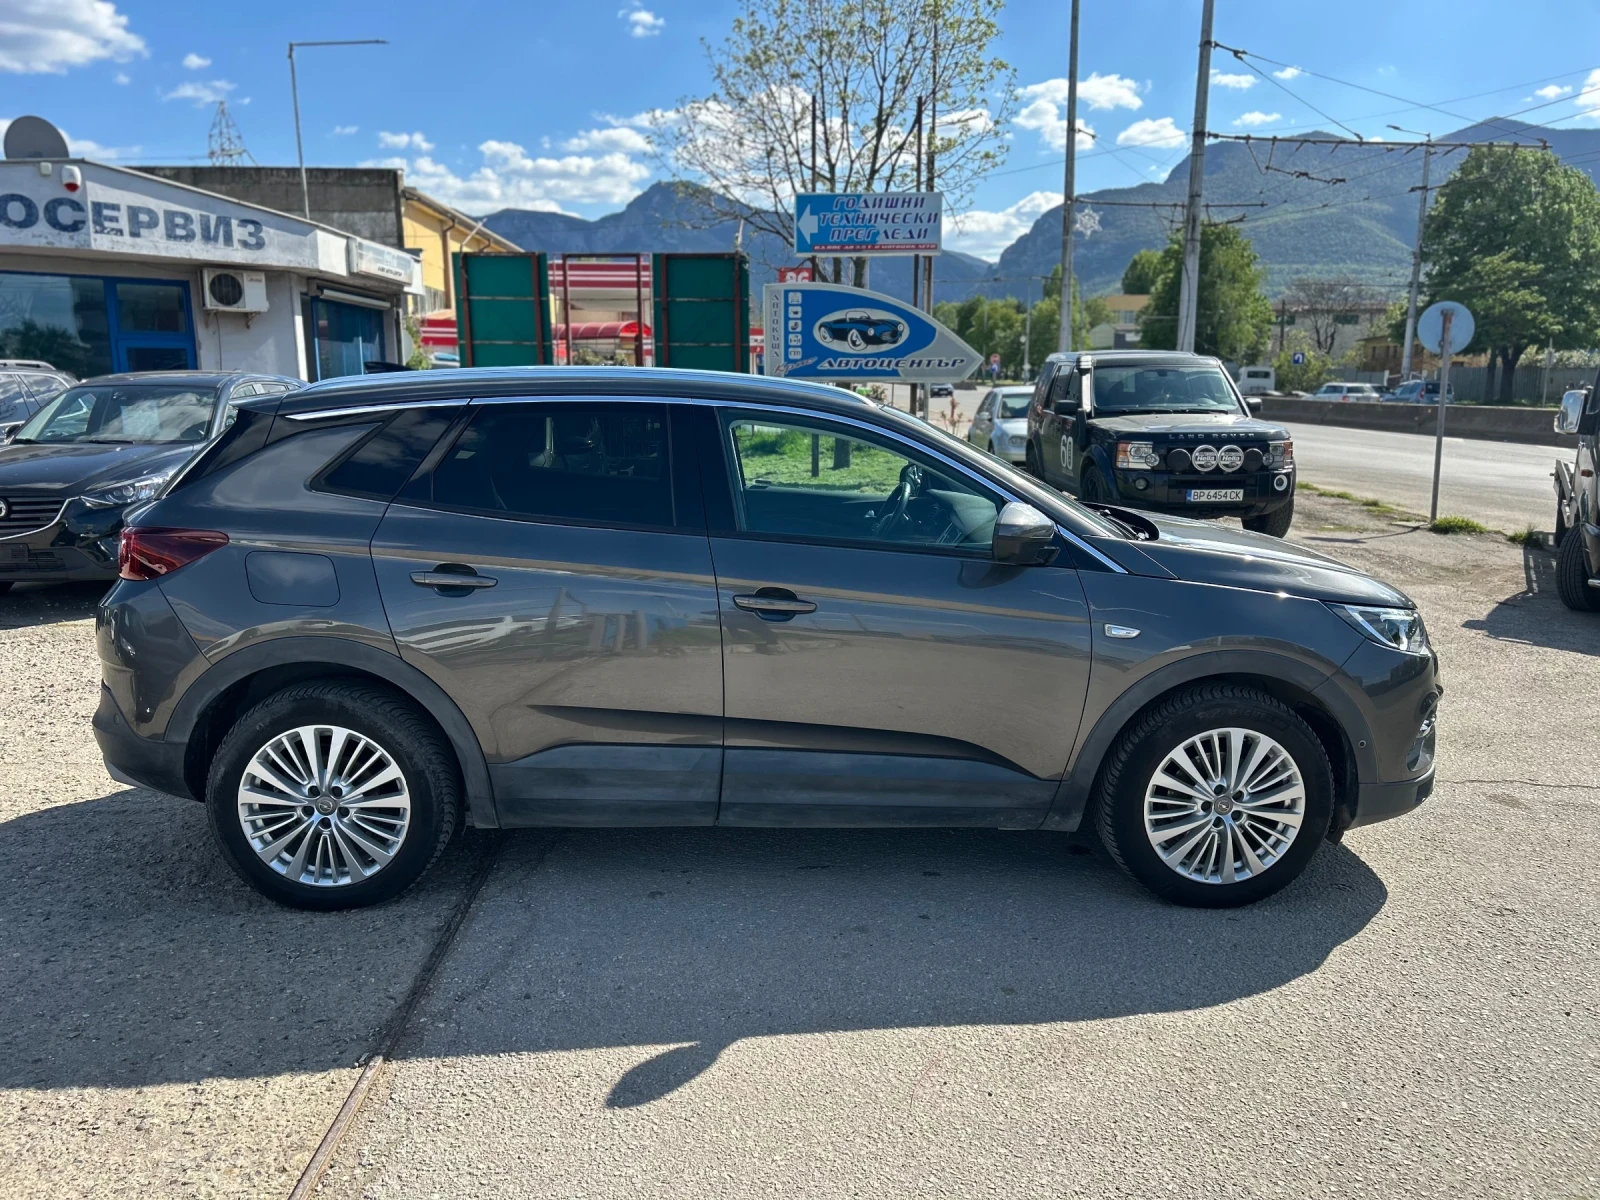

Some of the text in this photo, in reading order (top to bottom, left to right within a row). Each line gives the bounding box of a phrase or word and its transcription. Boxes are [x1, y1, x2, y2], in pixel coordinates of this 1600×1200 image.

[834, 196, 925, 209] ГОДИШНИ
[0, 193, 266, 250] ОСЕРВИЗ
[820, 212, 938, 225] ТЕХНИЧЕСКИ
[830, 228, 929, 241] ПРЕГЛЕДИ
[817, 357, 966, 370] АВТОЦЕНТЪР
[1060, 434, 1074, 470] 60
[1206, 490, 1228, 500] 6454
